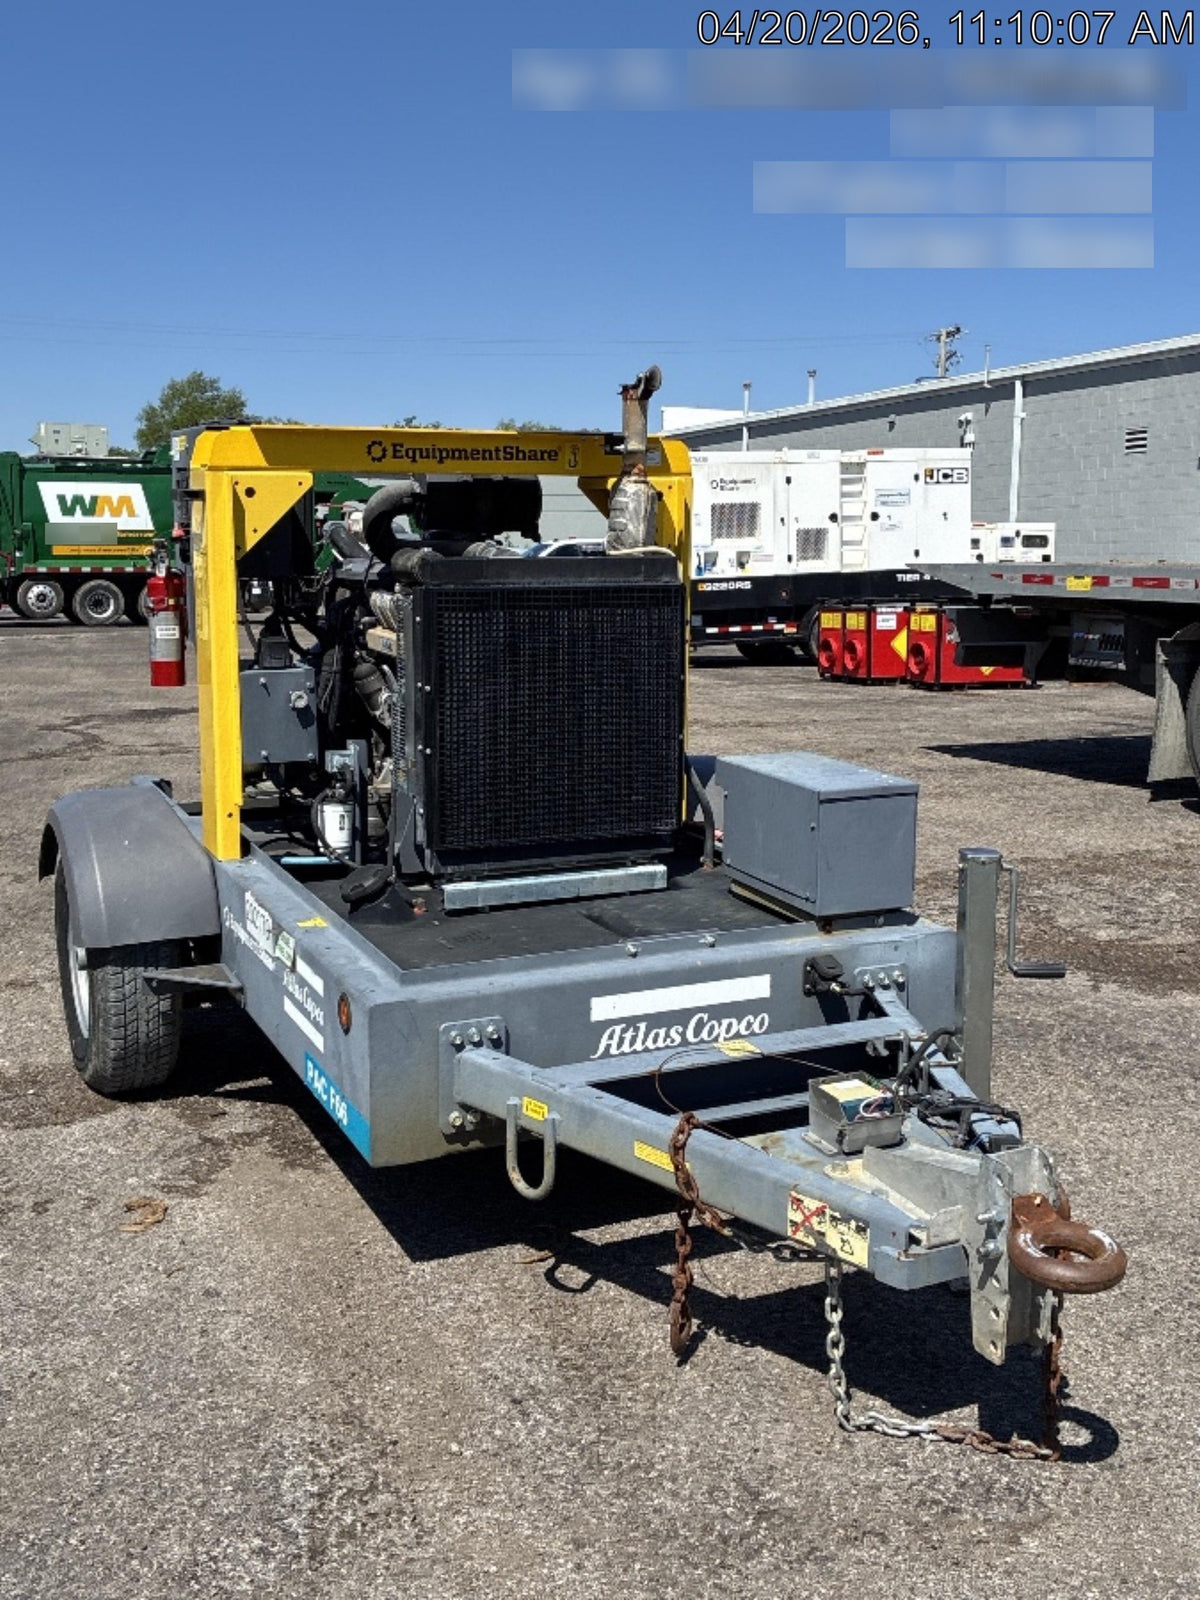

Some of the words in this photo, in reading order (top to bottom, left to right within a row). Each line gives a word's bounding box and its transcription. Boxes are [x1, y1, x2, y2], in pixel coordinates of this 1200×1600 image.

[391, 443, 559, 464] EquipmentShare
[925, 467, 968, 483] JCB
[57, 493, 137, 518] WM
[896, 573, 920, 583] TIER
[589, 1023, 683, 1059] Atlas
[686, 1012, 770, 1044] Copco
[306, 1058, 328, 1101] PAC
